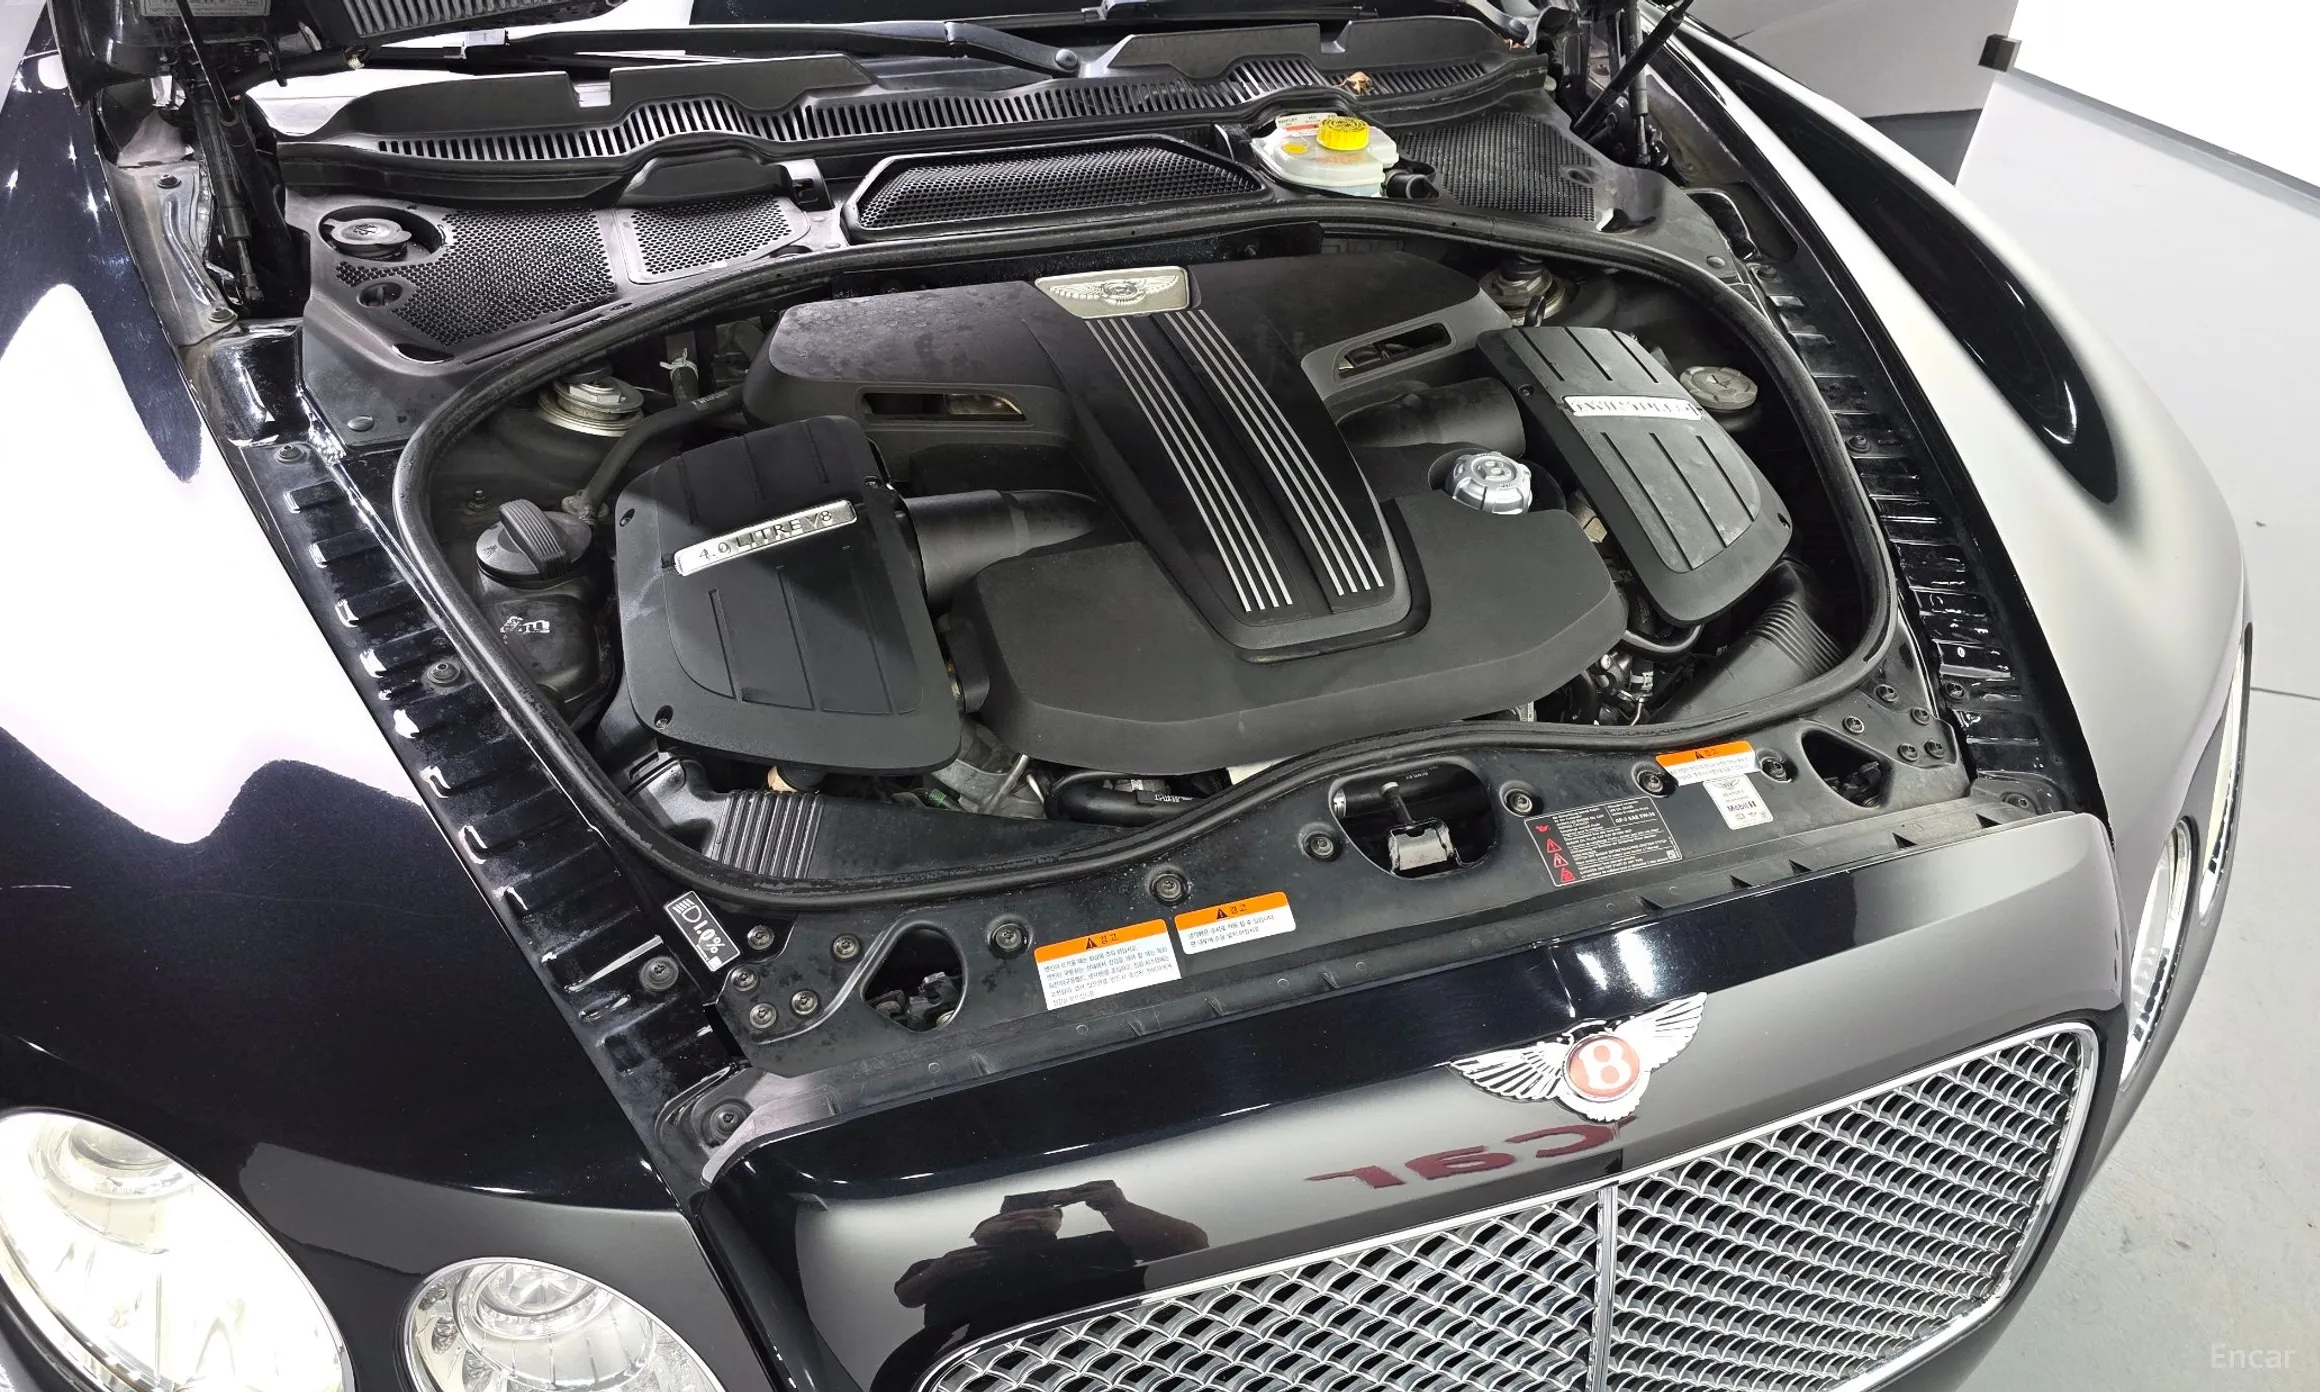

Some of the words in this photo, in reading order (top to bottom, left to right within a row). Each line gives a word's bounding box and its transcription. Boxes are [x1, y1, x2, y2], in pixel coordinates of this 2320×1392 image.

[699, 543, 732, 560] 4.0
[735, 518, 803, 547] LITRE
[806, 510, 833, 529] V8
[693, 919, 726, 954] 1.0%
[1579, 1038, 1634, 1092] B
